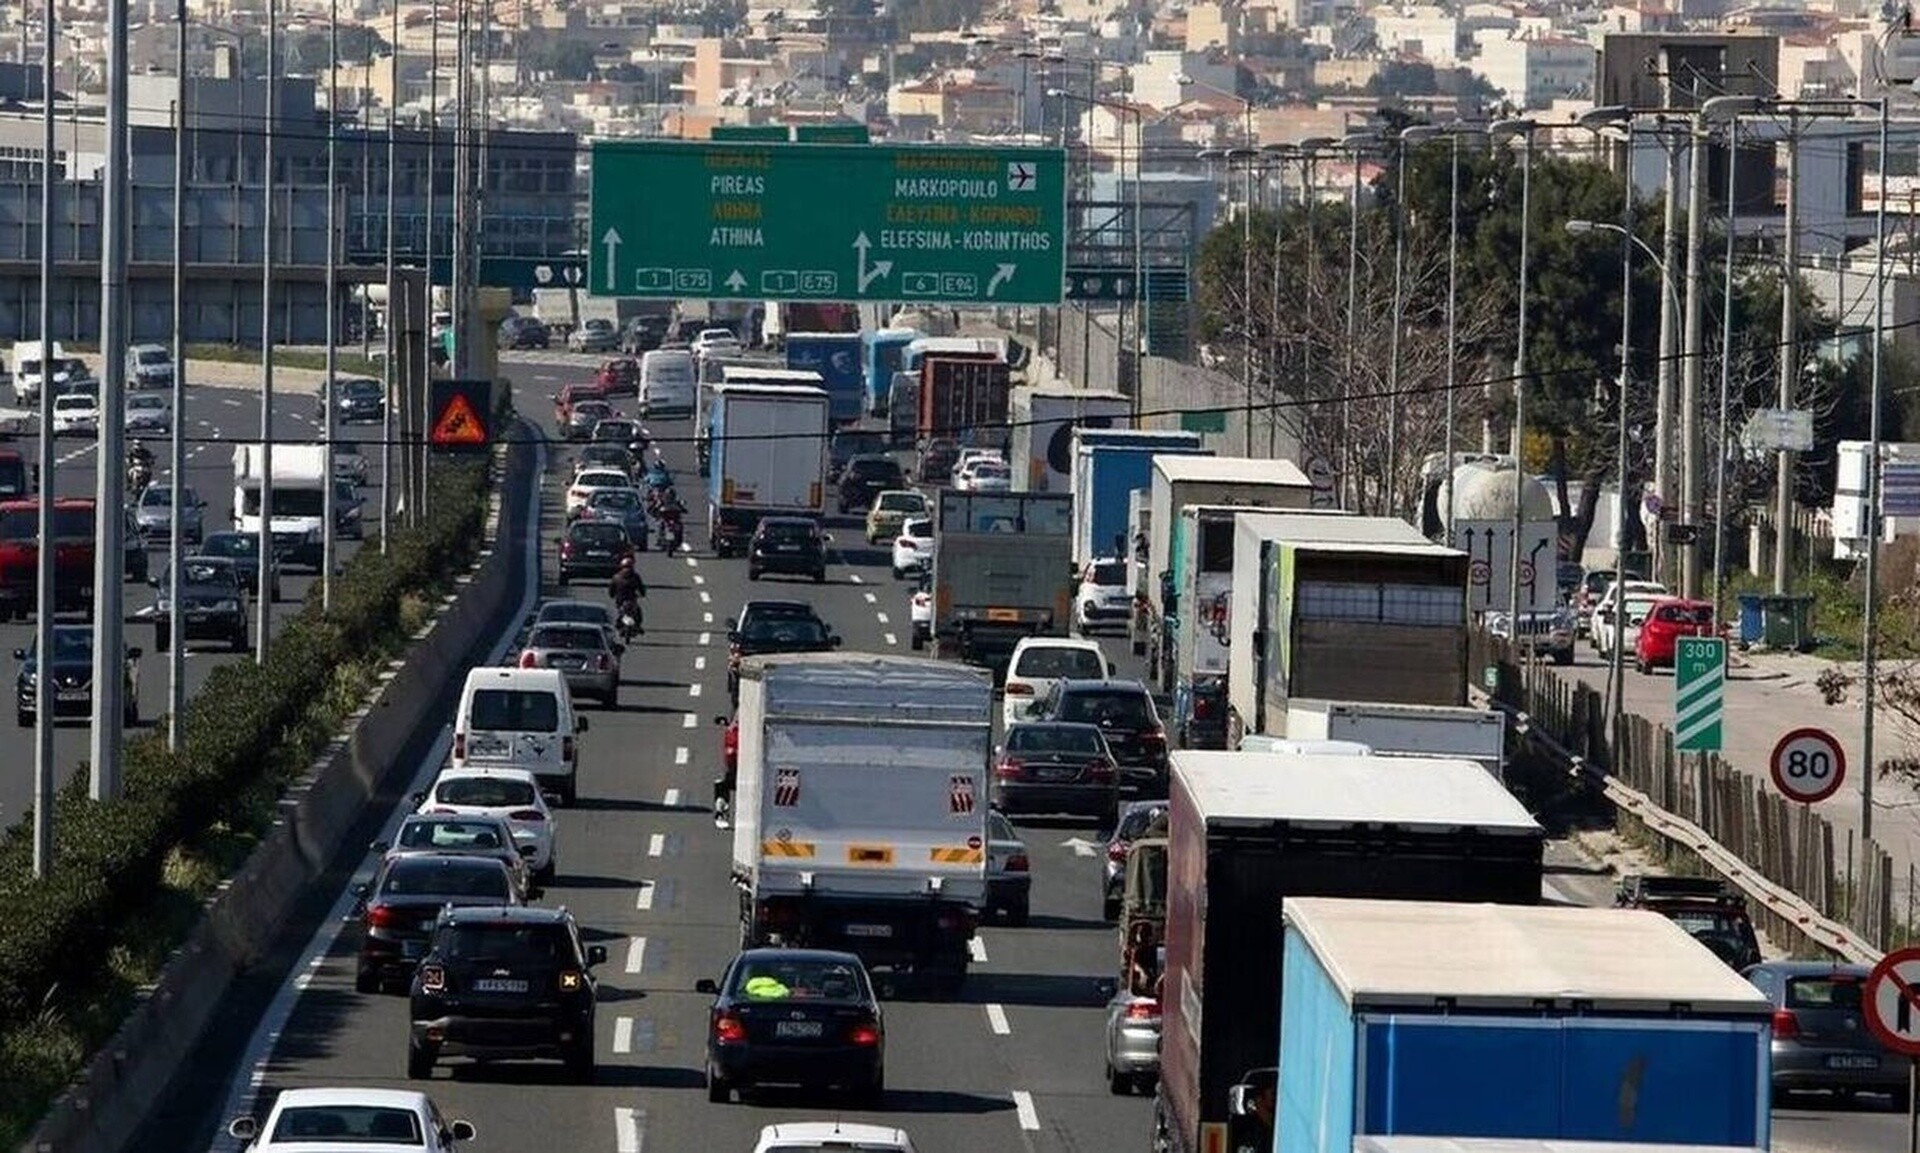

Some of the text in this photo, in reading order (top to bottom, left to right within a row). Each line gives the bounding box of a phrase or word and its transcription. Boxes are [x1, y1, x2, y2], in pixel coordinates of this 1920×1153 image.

[710, 176, 764, 194] PIREAS
[895, 179, 998, 198] MARKOPOULO
[710, 227, 764, 246] ATHINA
[679, 273, 707, 287] E75
[804, 275, 833, 289] E75
[916, 280, 926, 291] 6
[946, 278, 973, 291] E94
[1693, 662, 1706, 672] m
[1788, 750, 1829, 779] 80
